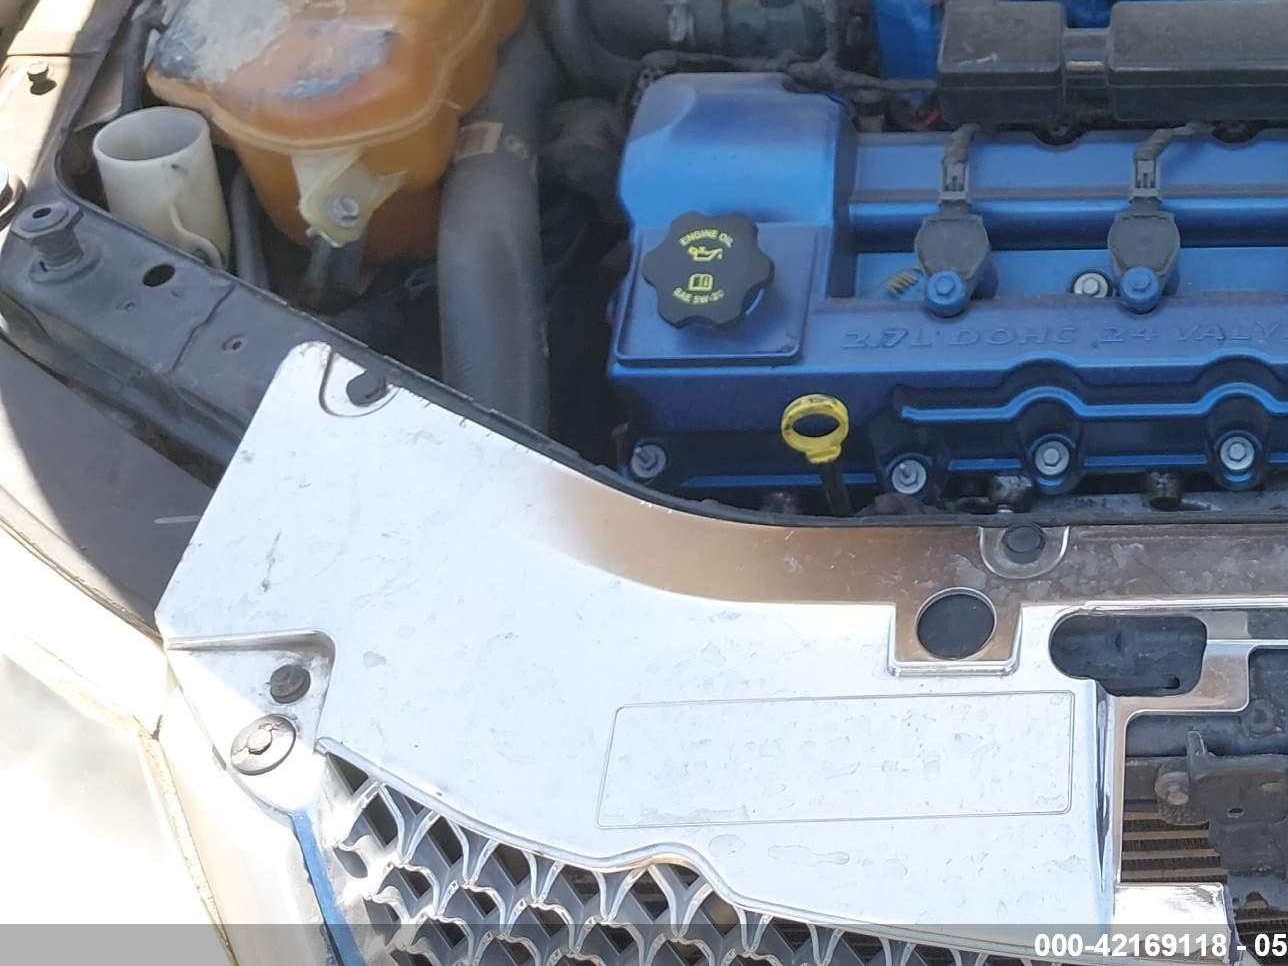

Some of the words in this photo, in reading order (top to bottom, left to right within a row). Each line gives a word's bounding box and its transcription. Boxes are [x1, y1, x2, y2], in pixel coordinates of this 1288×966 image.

[679, 229, 719, 247] ENGINE
[719, 232, 734, 248] OIL
[673, 287, 692, 303] SAE
[840, 328, 933, 349] 2.7L
[948, 327, 1077, 346] DOHC
[1100, 326, 1155, 344] 24
